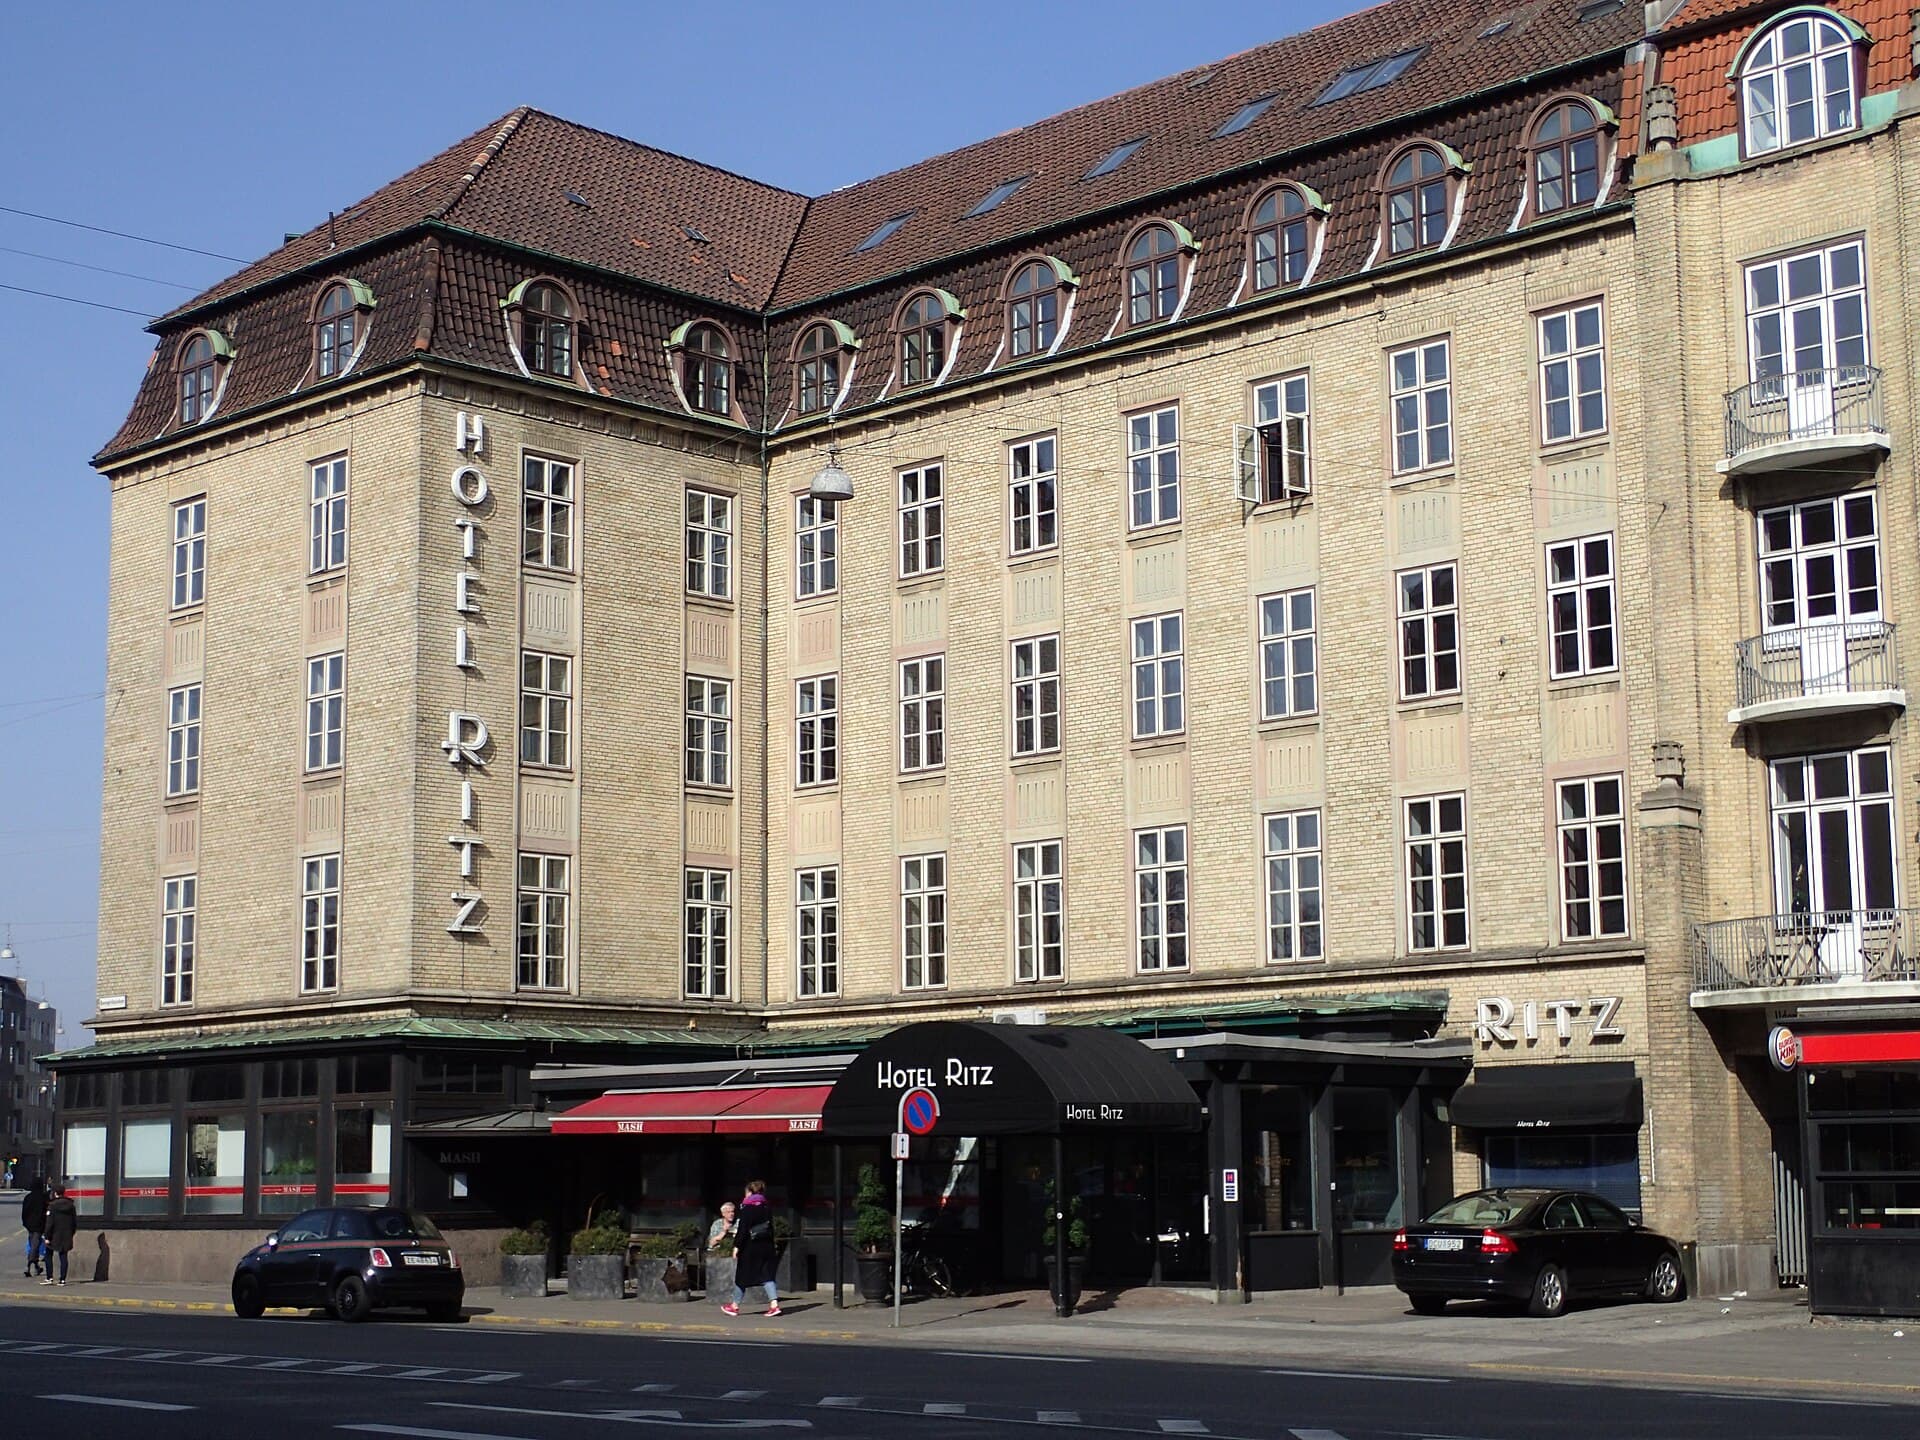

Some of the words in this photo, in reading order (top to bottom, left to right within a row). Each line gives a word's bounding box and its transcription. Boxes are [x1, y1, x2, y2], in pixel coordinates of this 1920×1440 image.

[450, 411, 488, 668] HOTEL
[441, 711, 489, 933] RITZ
[1472, 996, 1626, 1048] RITZ
[878, 1061, 937, 1089] HOTEL
[945, 1058, 994, 1086] RITZ
[1066, 1104, 1097, 1120] HOTEL
[1100, 1104, 1123, 1120] RITZ
[617, 1121, 643, 1133] MASH
[789, 1119, 818, 1131] MASH
[439, 1151, 481, 1164] MASH
